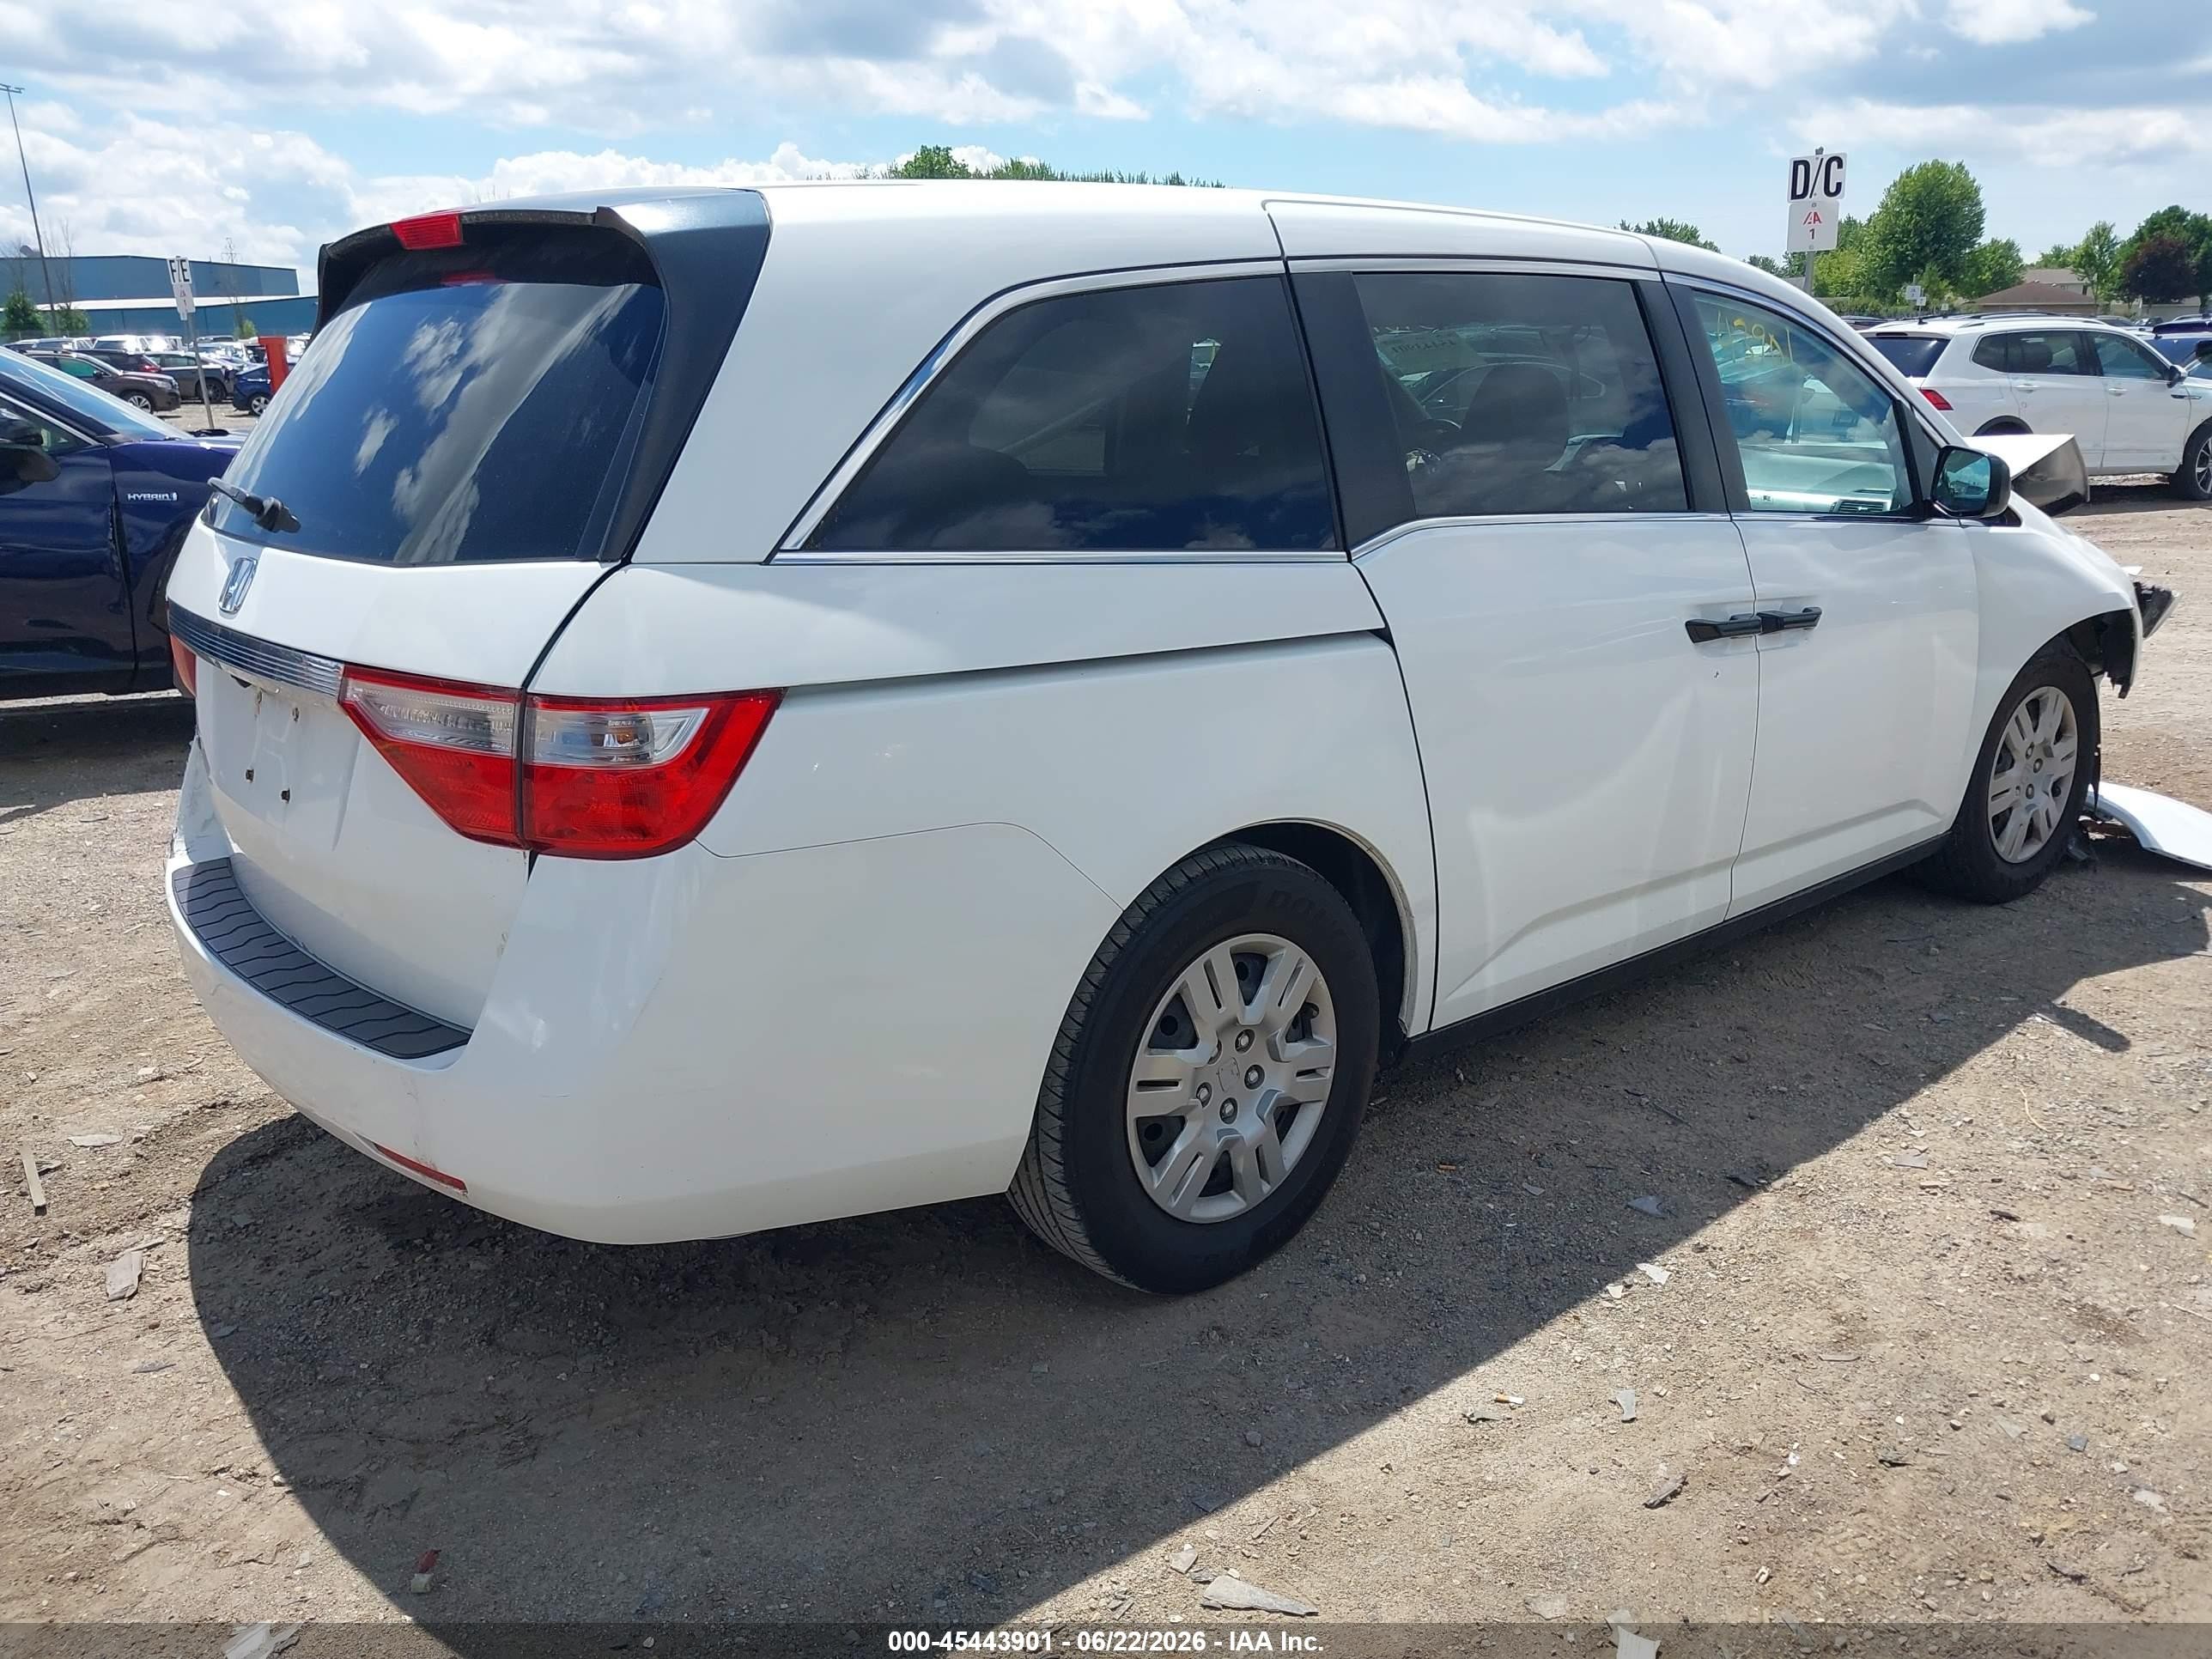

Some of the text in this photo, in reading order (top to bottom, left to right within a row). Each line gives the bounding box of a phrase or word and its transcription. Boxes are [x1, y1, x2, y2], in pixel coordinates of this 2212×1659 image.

[1790, 155, 1844, 200] D/C
[1809, 228, 1815, 240] 1
[169, 259, 191, 283] F/E
[127, 493, 172, 501] HYBRID
